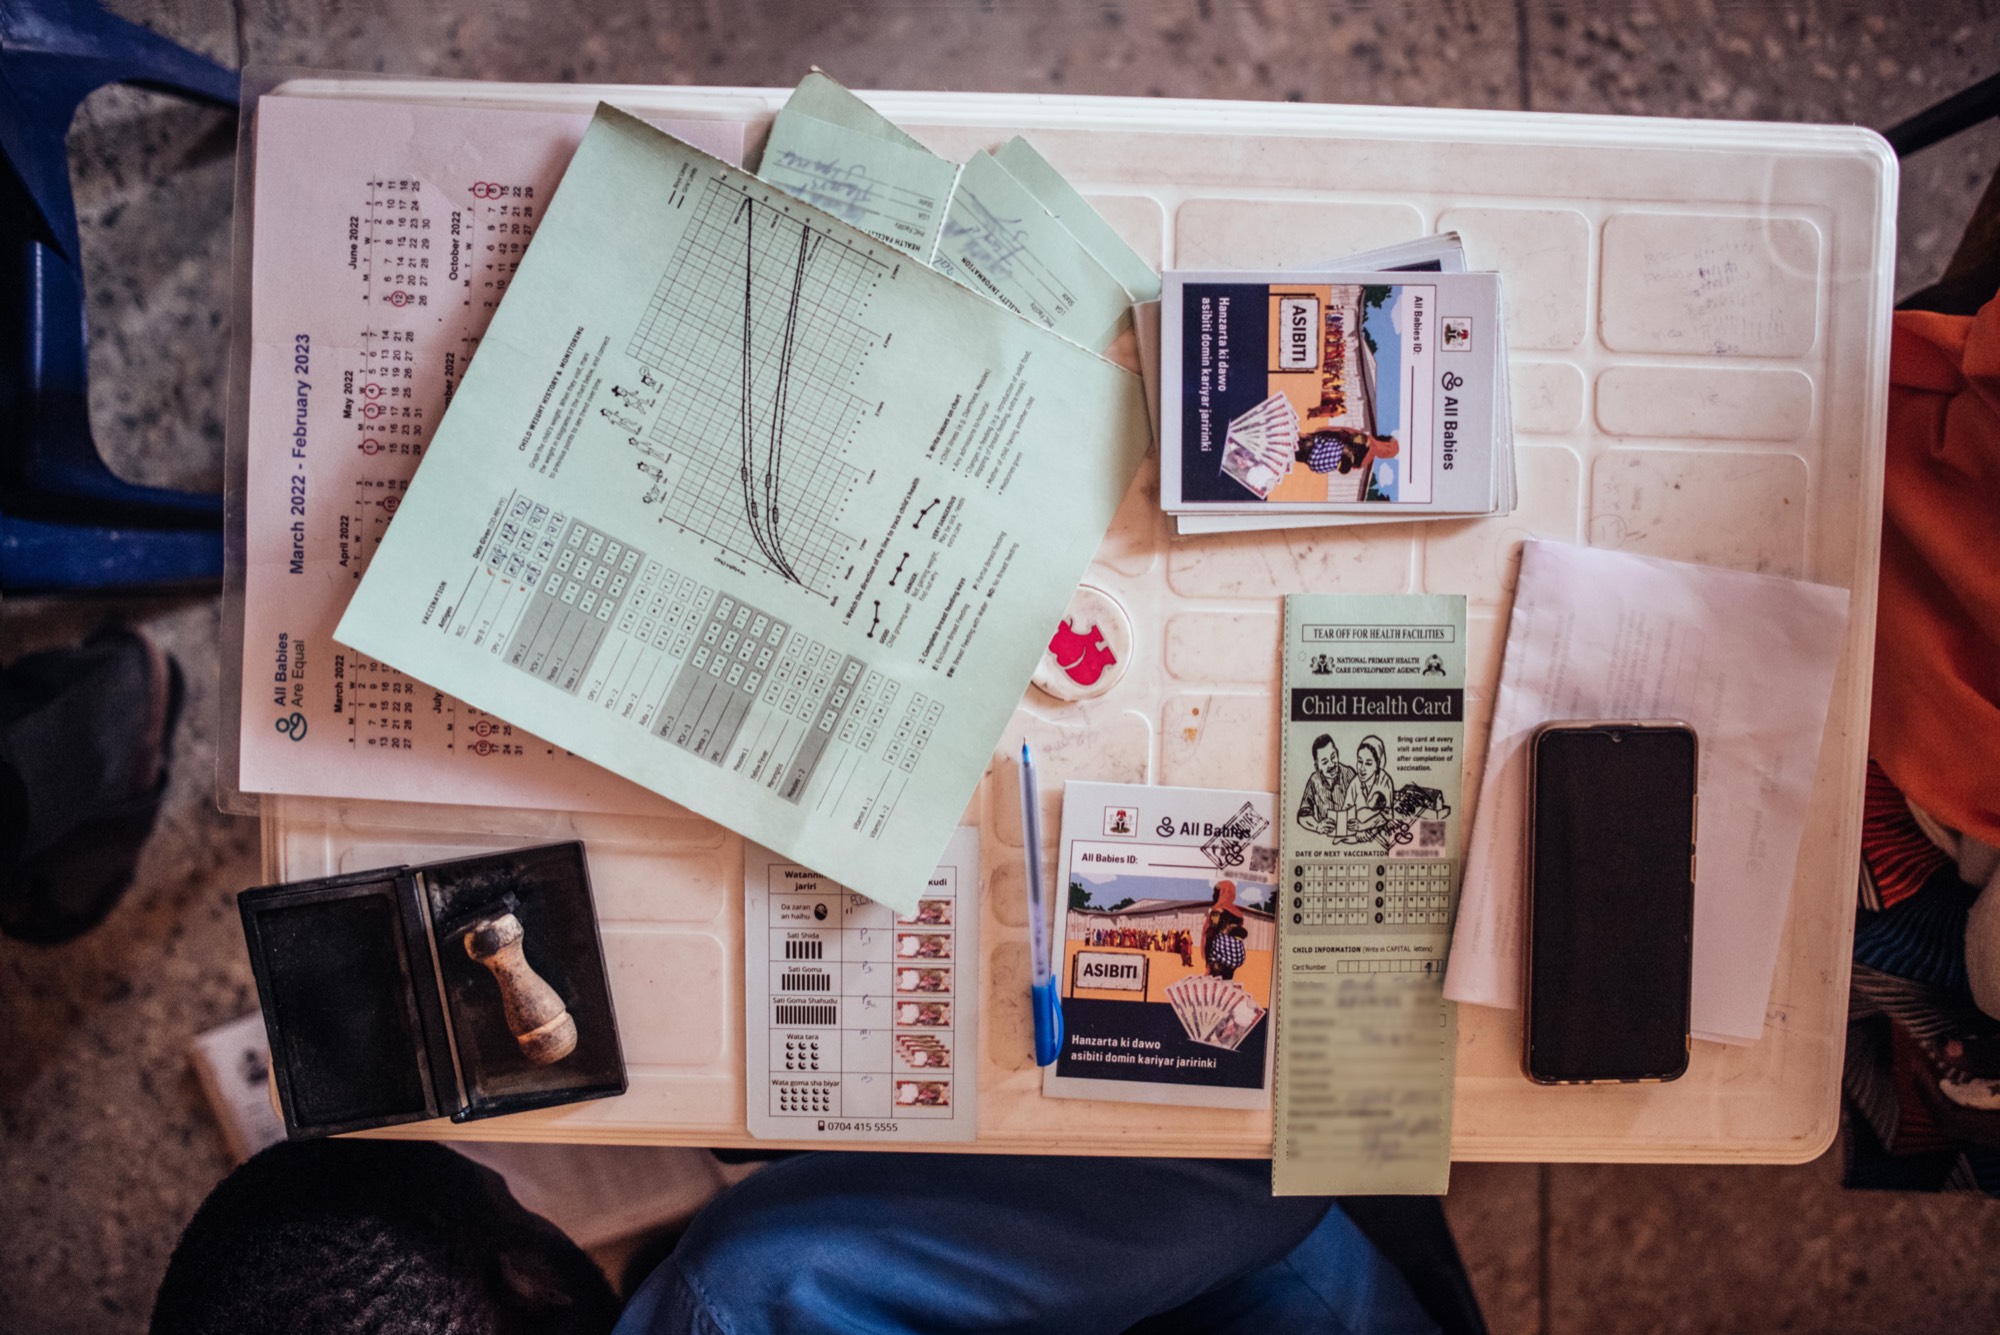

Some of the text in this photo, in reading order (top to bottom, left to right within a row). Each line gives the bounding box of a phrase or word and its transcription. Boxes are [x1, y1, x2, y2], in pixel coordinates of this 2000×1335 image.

[348, 216, 358, 270] June 2022
[418, 219, 430, 306] 26 27 28 29 30
[448, 211, 460, 280] October 2022
[895, 239, 920, 251] HEALTH
[961, 257, 1021, 314] ACILITY INFORMATION
[1217, 297, 1230, 392] Hanzarta ki dawo
[1292, 305, 1307, 362] ASIBITI
[1413, 296, 1423, 355] All Babies ID:
[294, 334, 310, 375] 2023
[444, 352, 454, 376] 2022
[1198, 297, 1212, 451] asibiti domin kariyar jaririnki
[343, 370, 354, 419] May 2022
[518, 431, 532, 451] CHILD
[529, 404, 544, 430] WEIGHT
[542, 376, 558, 404] HISTORY
[559, 326, 584, 368] MONITORING
[292, 380, 312, 458] February
[1443, 396, 1458, 470] All Babies
[290, 475, 305, 516] 2022
[289, 522, 304, 574] March
[339, 515, 349, 567] April 2022
[472, 528, 491, 558] Date Given
[846, 601, 857, 618] Watch
[855, 591, 863, 600] the
[860, 565, 876, 590] direction
[873, 557, 879, 565] of
[876, 548, 884, 558] the
[881, 537, 890, 548] line
[890, 514, 901, 529] track
[899, 495, 911, 514] child's
[907, 477, 920, 496] health
[422, 581, 447, 624] VACCINATION
[438, 606, 452, 628] Antigen
[1314, 628, 1444, 639] TEAR OFF FOR HEALTH FACILITIES
[274, 632, 288, 706] All Babies
[290, 640, 306, 708] Are Equal
[334, 655, 344, 713] March 2022
[379, 682, 389, 746] 13 14 15 16
[432, 692, 443, 714] July
[1302, 695, 1451, 715] Child Health Card
[1397, 736, 1413, 744] Bring
[1179, 822, 1252, 839] All Babies
[1081, 853, 1138, 864] All Babies ID:
[794, 882, 816, 892] jariri
[1083, 963, 1137, 979] ASIBITI
[1070, 1050, 1216, 1068] asibiti domin kariyar jaririnki
[1071, 1034, 1161, 1050] Hanzarta ki dawo
[827, 1122, 898, 1132] 0704 415 5555
